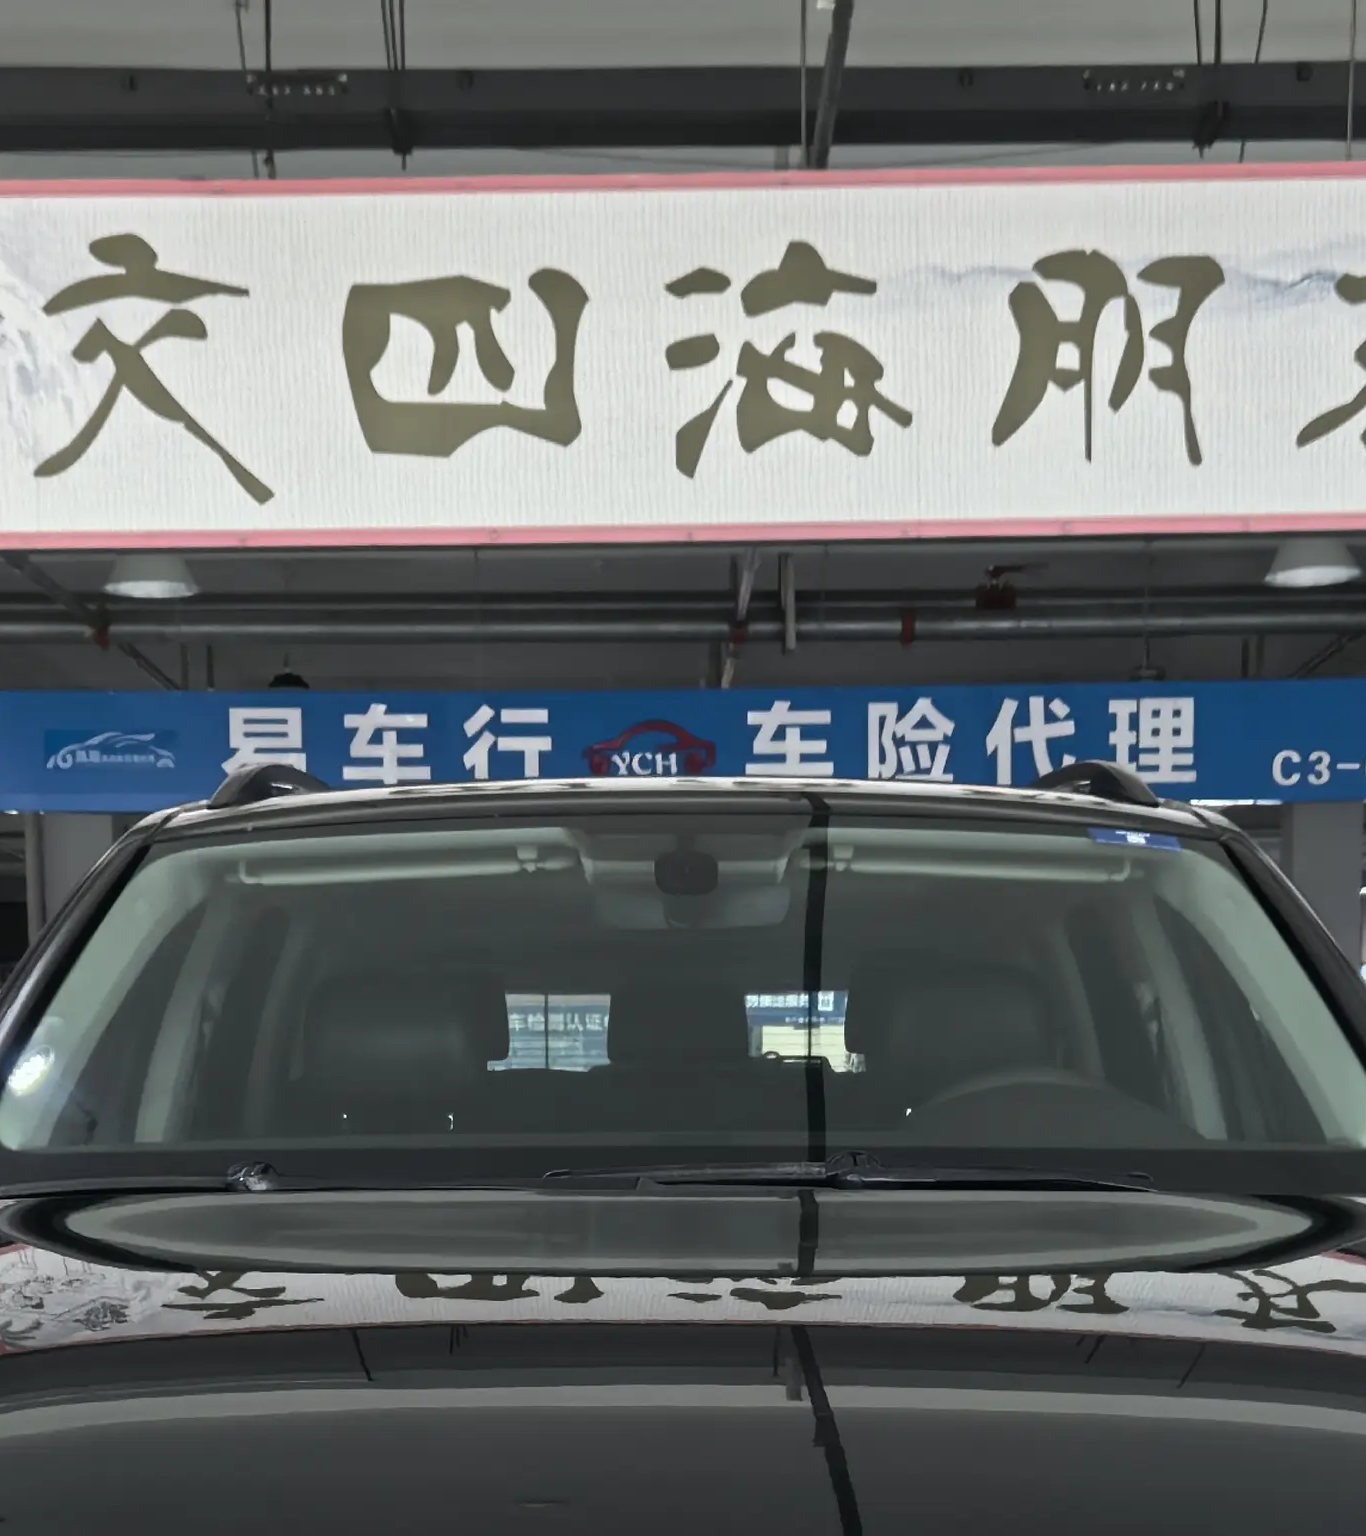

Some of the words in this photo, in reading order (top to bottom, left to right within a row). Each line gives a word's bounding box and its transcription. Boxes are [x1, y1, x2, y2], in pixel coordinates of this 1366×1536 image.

[221, 702, 552, 784] 易车行
[612, 751, 678, 776] YCH
[745, 697, 1197, 784] 车险代理
